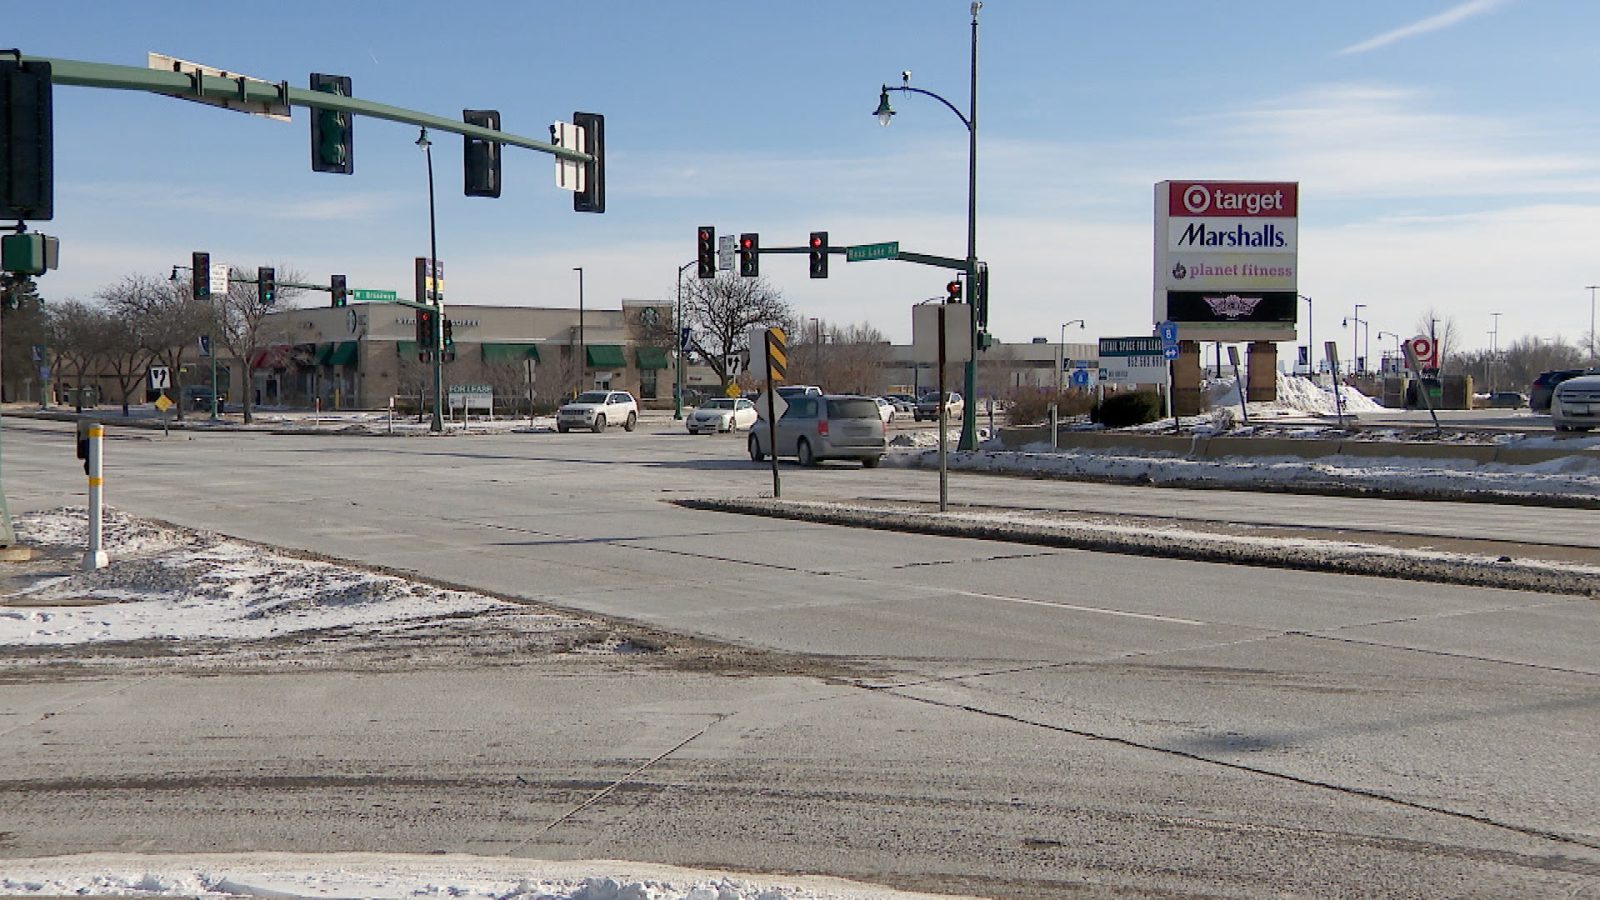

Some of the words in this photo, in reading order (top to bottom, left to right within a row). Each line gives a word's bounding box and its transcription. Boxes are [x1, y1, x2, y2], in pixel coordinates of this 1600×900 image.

[1214, 189, 1283, 214] target
[887, 245, 897, 254] Rd
[1190, 263, 1238, 279] planet
[1242, 262, 1293, 276] fitness
[365, 291, 395, 300] Broadway
[1165, 329, 1172, 339] 8
[1120, 340, 1136, 351] SPACE
[1137, 340, 1147, 350] FOR
[1148, 340, 1162, 350] LEAS
